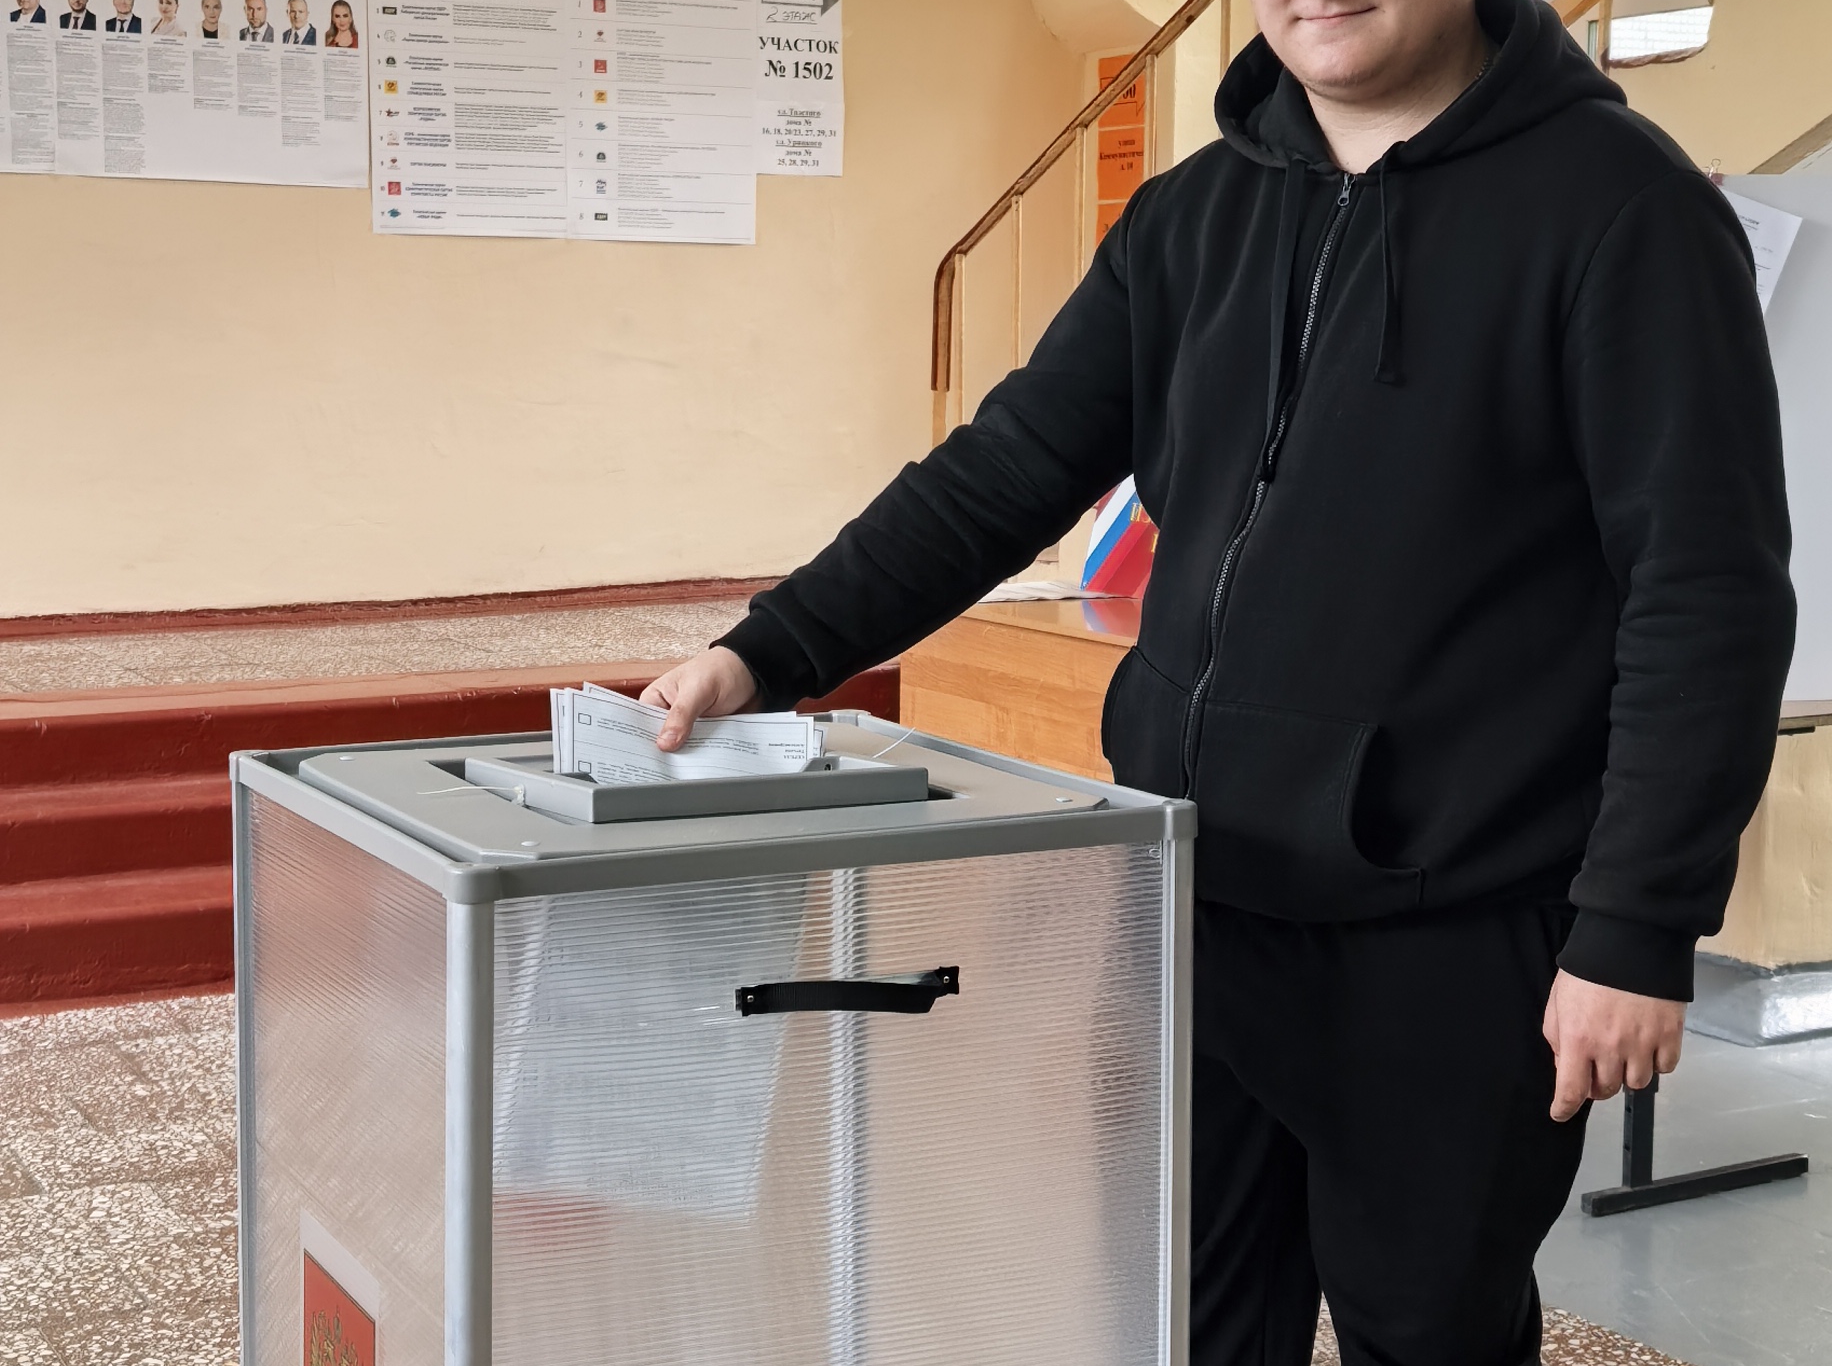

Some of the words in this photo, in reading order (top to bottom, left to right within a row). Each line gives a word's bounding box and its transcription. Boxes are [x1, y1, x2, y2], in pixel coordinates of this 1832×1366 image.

[766, 6, 779, 22] 2
[758, 36, 839, 54] УЧАСТОК
[764, 59, 786, 78] №
[793, 61, 834, 80] 1502
